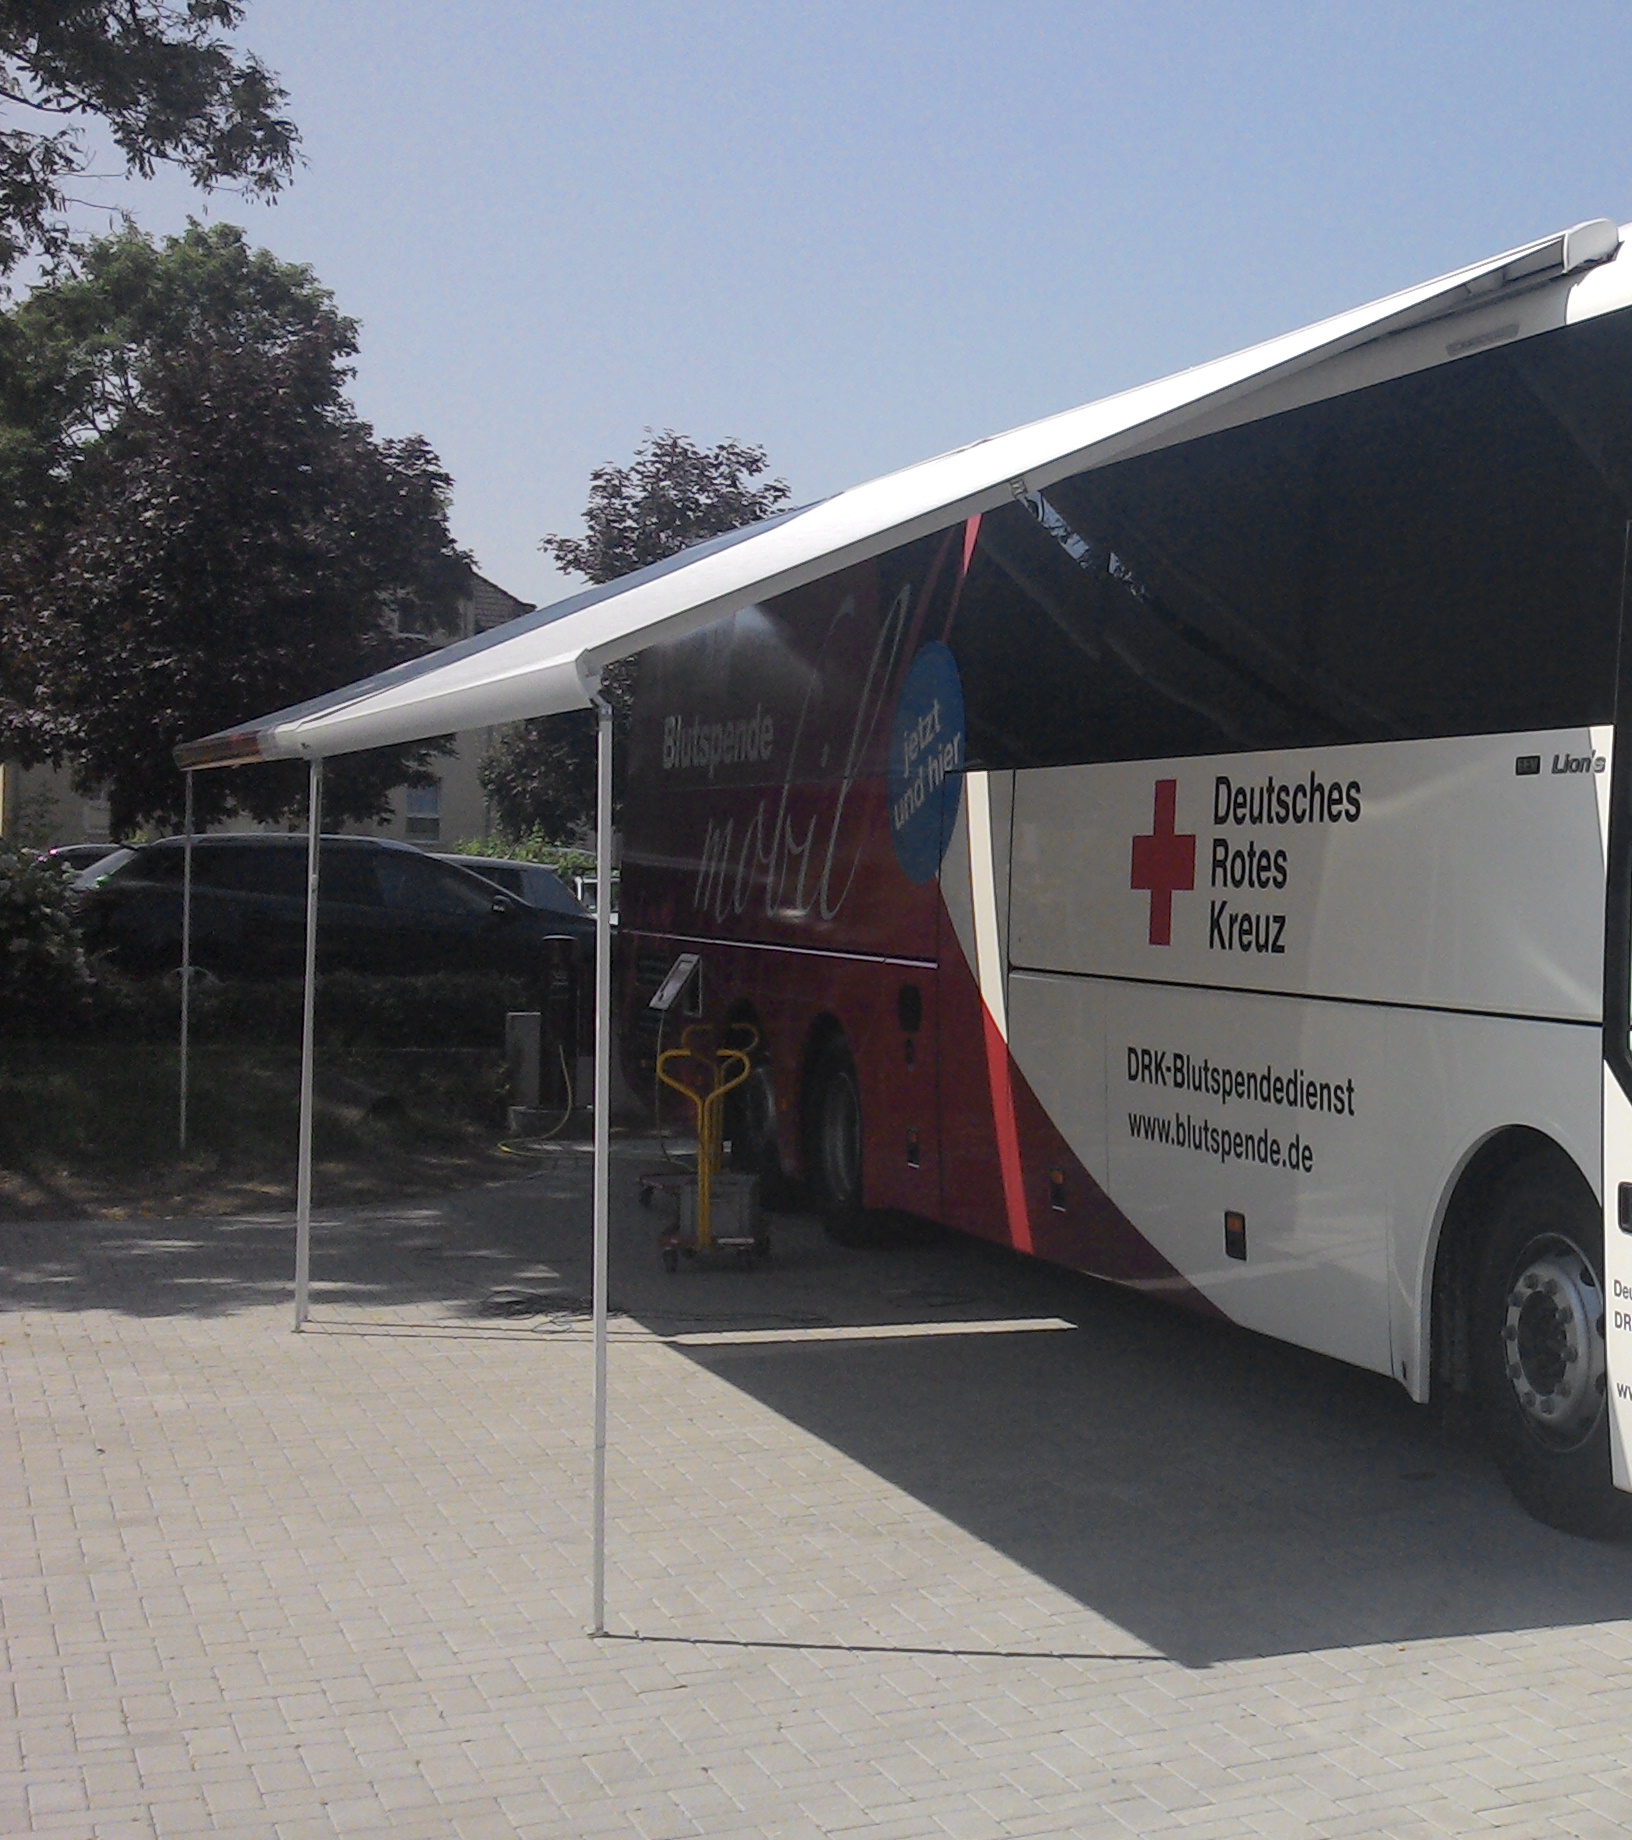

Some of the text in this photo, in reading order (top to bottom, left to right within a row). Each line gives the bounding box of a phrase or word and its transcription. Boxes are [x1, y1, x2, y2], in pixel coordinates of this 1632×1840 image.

[662, 702, 775, 779] Blutspende
[902, 699, 941, 778] jetzt
[1551, 750, 1607, 775] Lion's
[892, 731, 962, 831] und hier
[1213, 770, 1361, 826] Deutsches
[1210, 837, 1288, 889] Rotes
[1208, 900, 1287, 953] Kreuz
[1127, 1046, 1355, 1116] DRK-Blutspendedienst
[1128, 1111, 1314, 1173] www.blutspende.de
